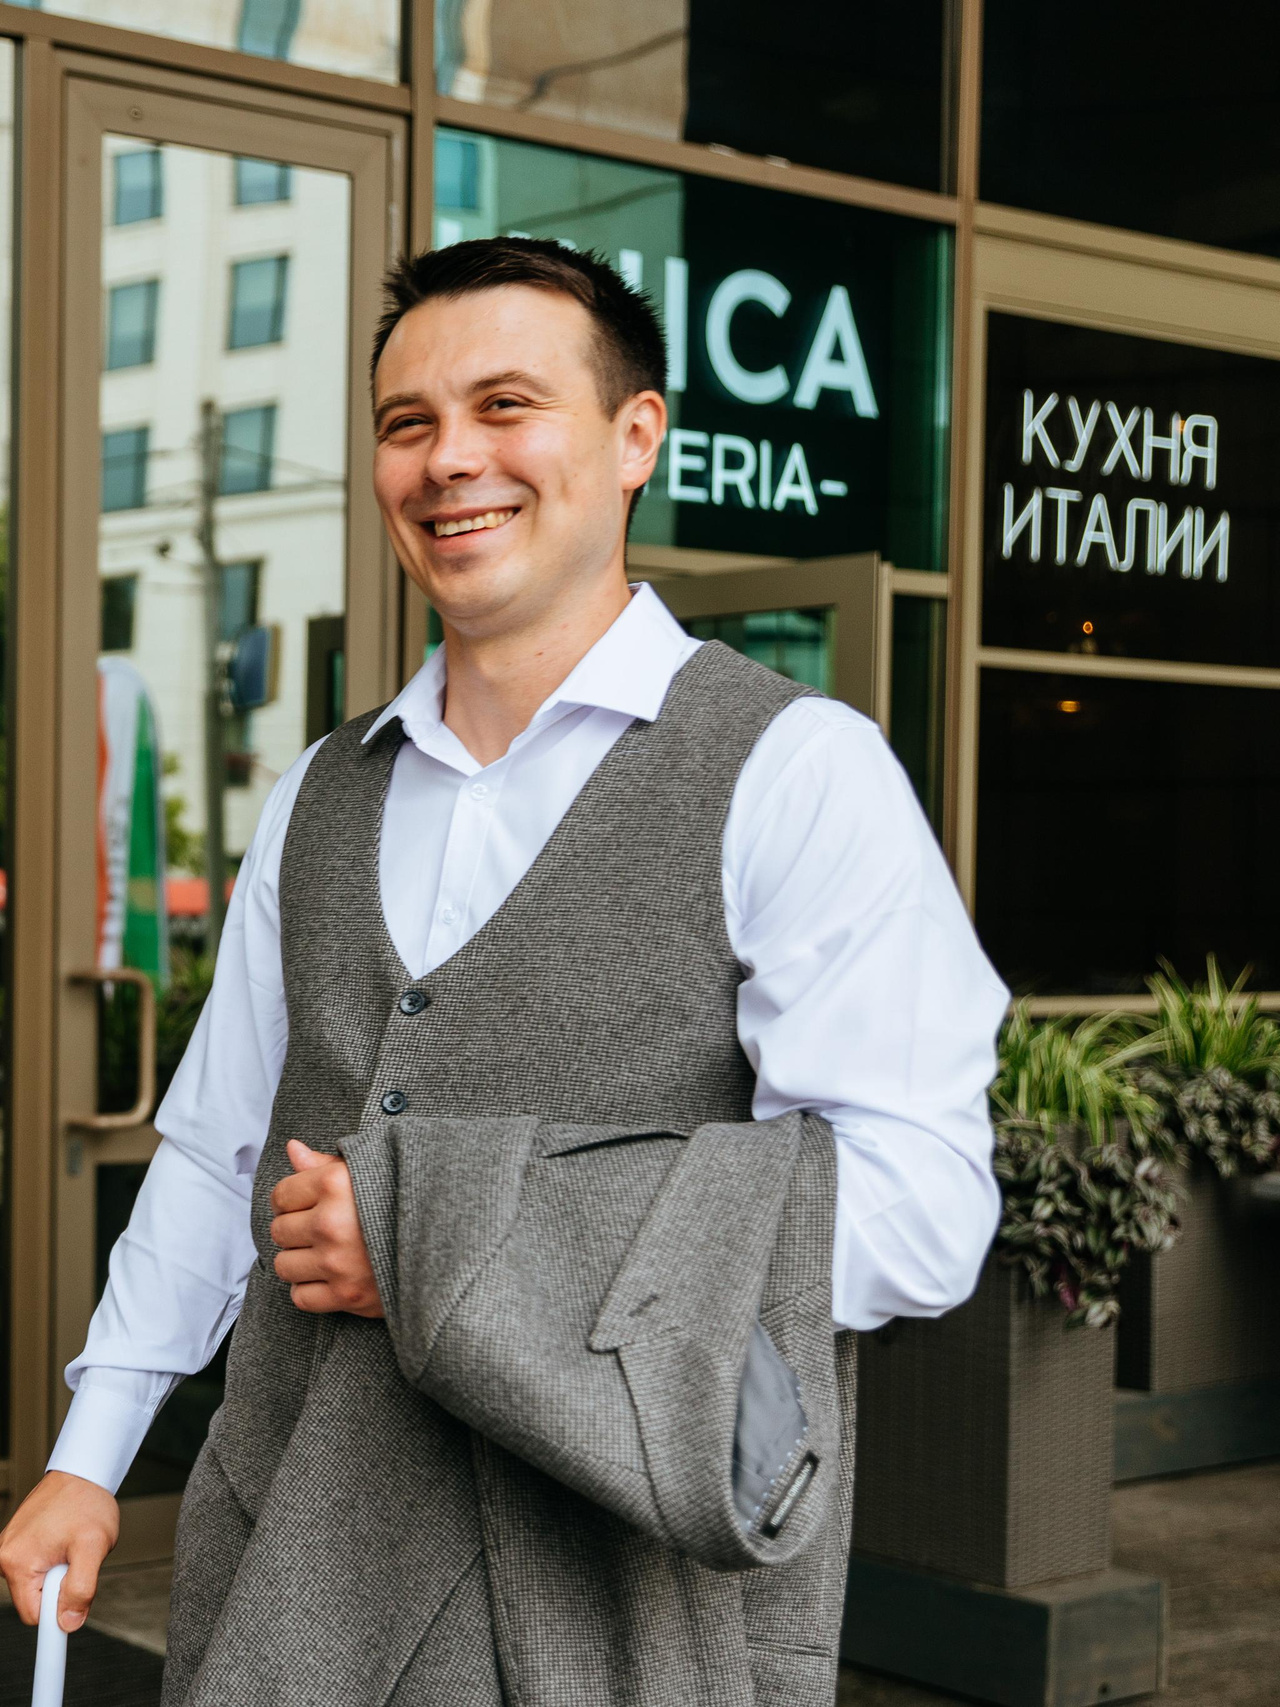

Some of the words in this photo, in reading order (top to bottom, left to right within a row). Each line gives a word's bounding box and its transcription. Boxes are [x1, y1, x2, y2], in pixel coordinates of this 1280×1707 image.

[643, 428, 849, 516] ERIA-
[1022, 387, 1219, 491] КУХНЯ
[1002, 482, 1231, 584] ИТАЛИИ
